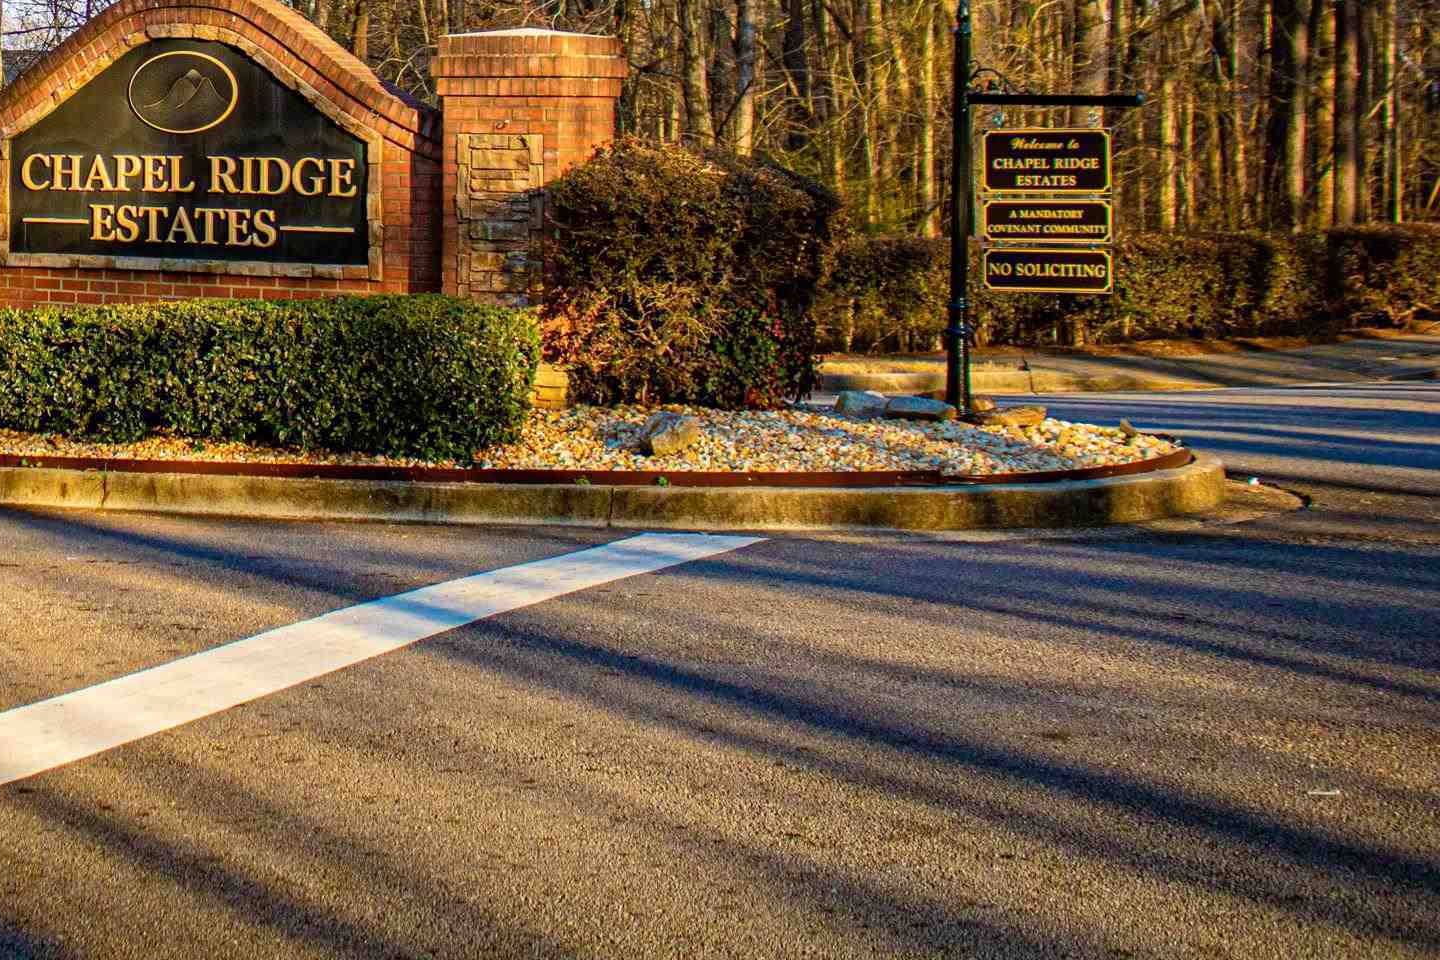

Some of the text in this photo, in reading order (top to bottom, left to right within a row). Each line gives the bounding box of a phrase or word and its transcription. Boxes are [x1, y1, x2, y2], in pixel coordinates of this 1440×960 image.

[1011, 137, 1080, 150] Welcome to
[992, 158, 1100, 169] CHAPEL RIDGE
[21, 153, 358, 198] CHAPEL RIDGE
[1016, 175, 1077, 186] ESTATES
[1009, 210, 1084, 219] A MANDATORY
[89, 203, 279, 248] ESTATES
[988, 224, 1107, 234] COVENANT COMMUNITY
[989, 263, 1106, 278] NO SOLICITING
